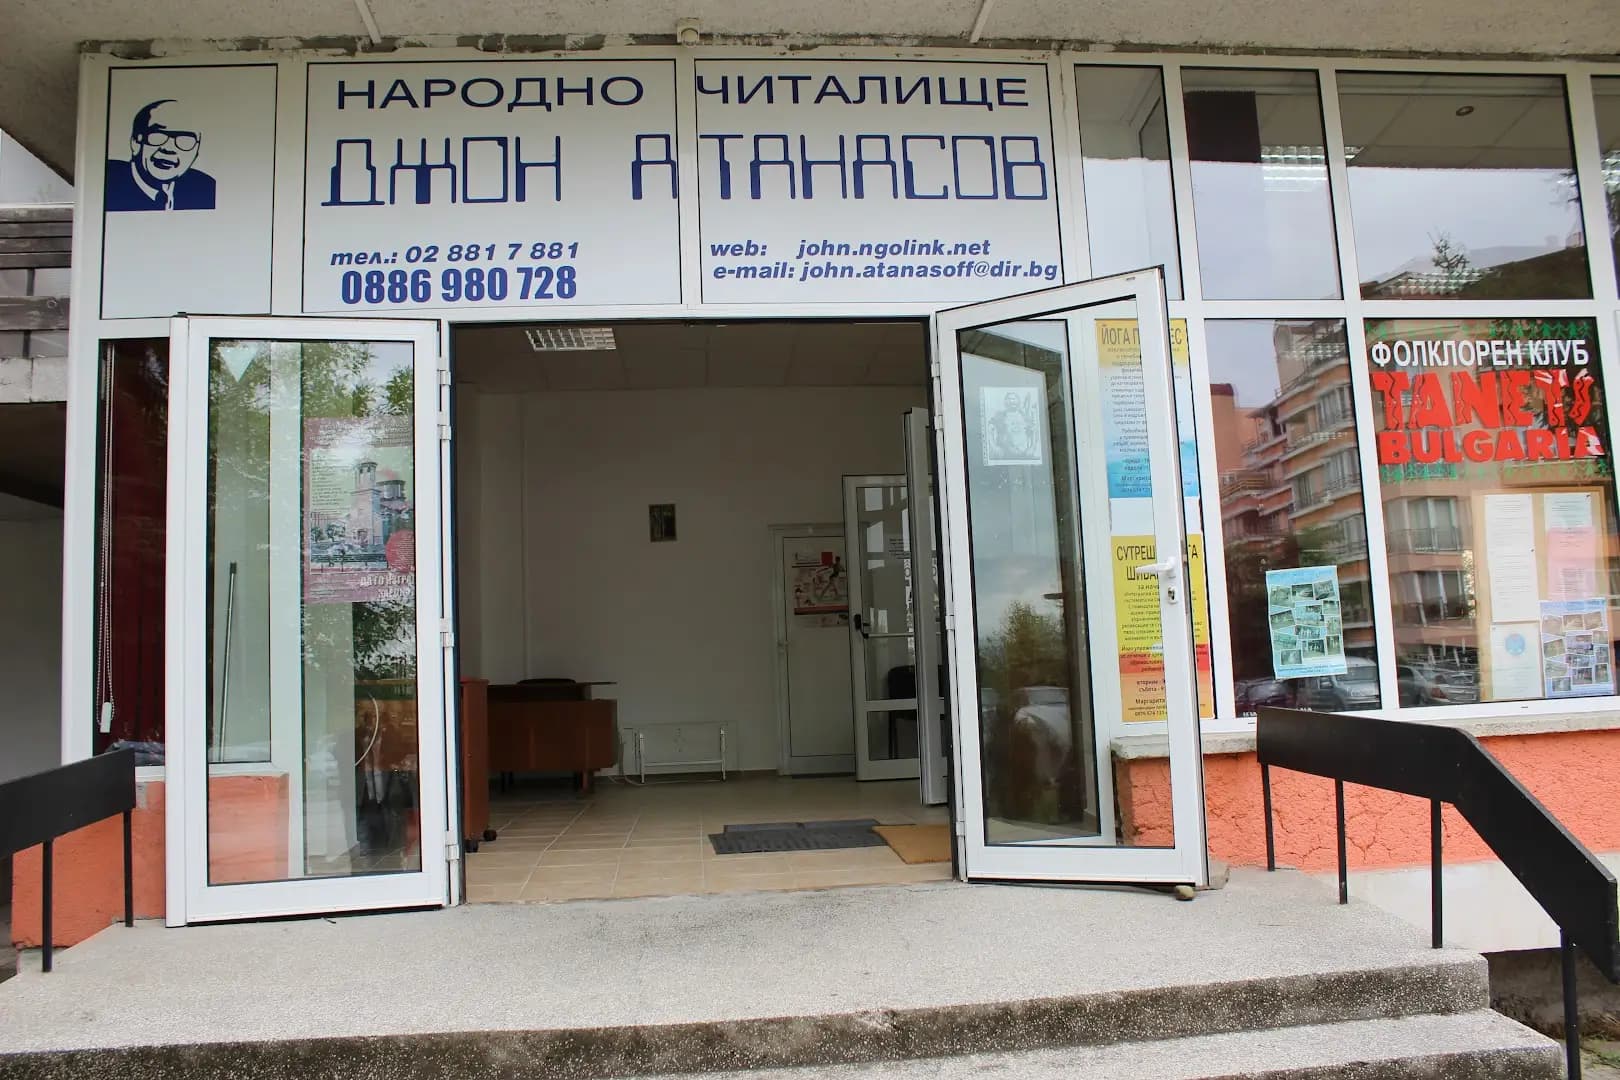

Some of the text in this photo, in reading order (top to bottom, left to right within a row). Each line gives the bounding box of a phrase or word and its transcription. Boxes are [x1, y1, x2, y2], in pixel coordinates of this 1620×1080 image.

[337, 75, 1029, 112] НАРОДНО ЧИТАЛИЩЕ
[321, 136, 561, 206] ДЖОН
[405, 245, 438, 264] 02
[447, 243, 496, 262] 881
[507, 242, 522, 260] 7
[529, 241, 579, 260] 881
[710, 239, 990, 260] web: john.ngolink.net
[341, 265, 577, 304] 0886 980 728
[713, 260, 1058, 282] e-mail: john.atanasoff@dir.bg
[1371, 339, 1590, 367] ФОЛКЛОРЕН КЛУБ
[1377, 426, 1606, 464] BULGARIA
